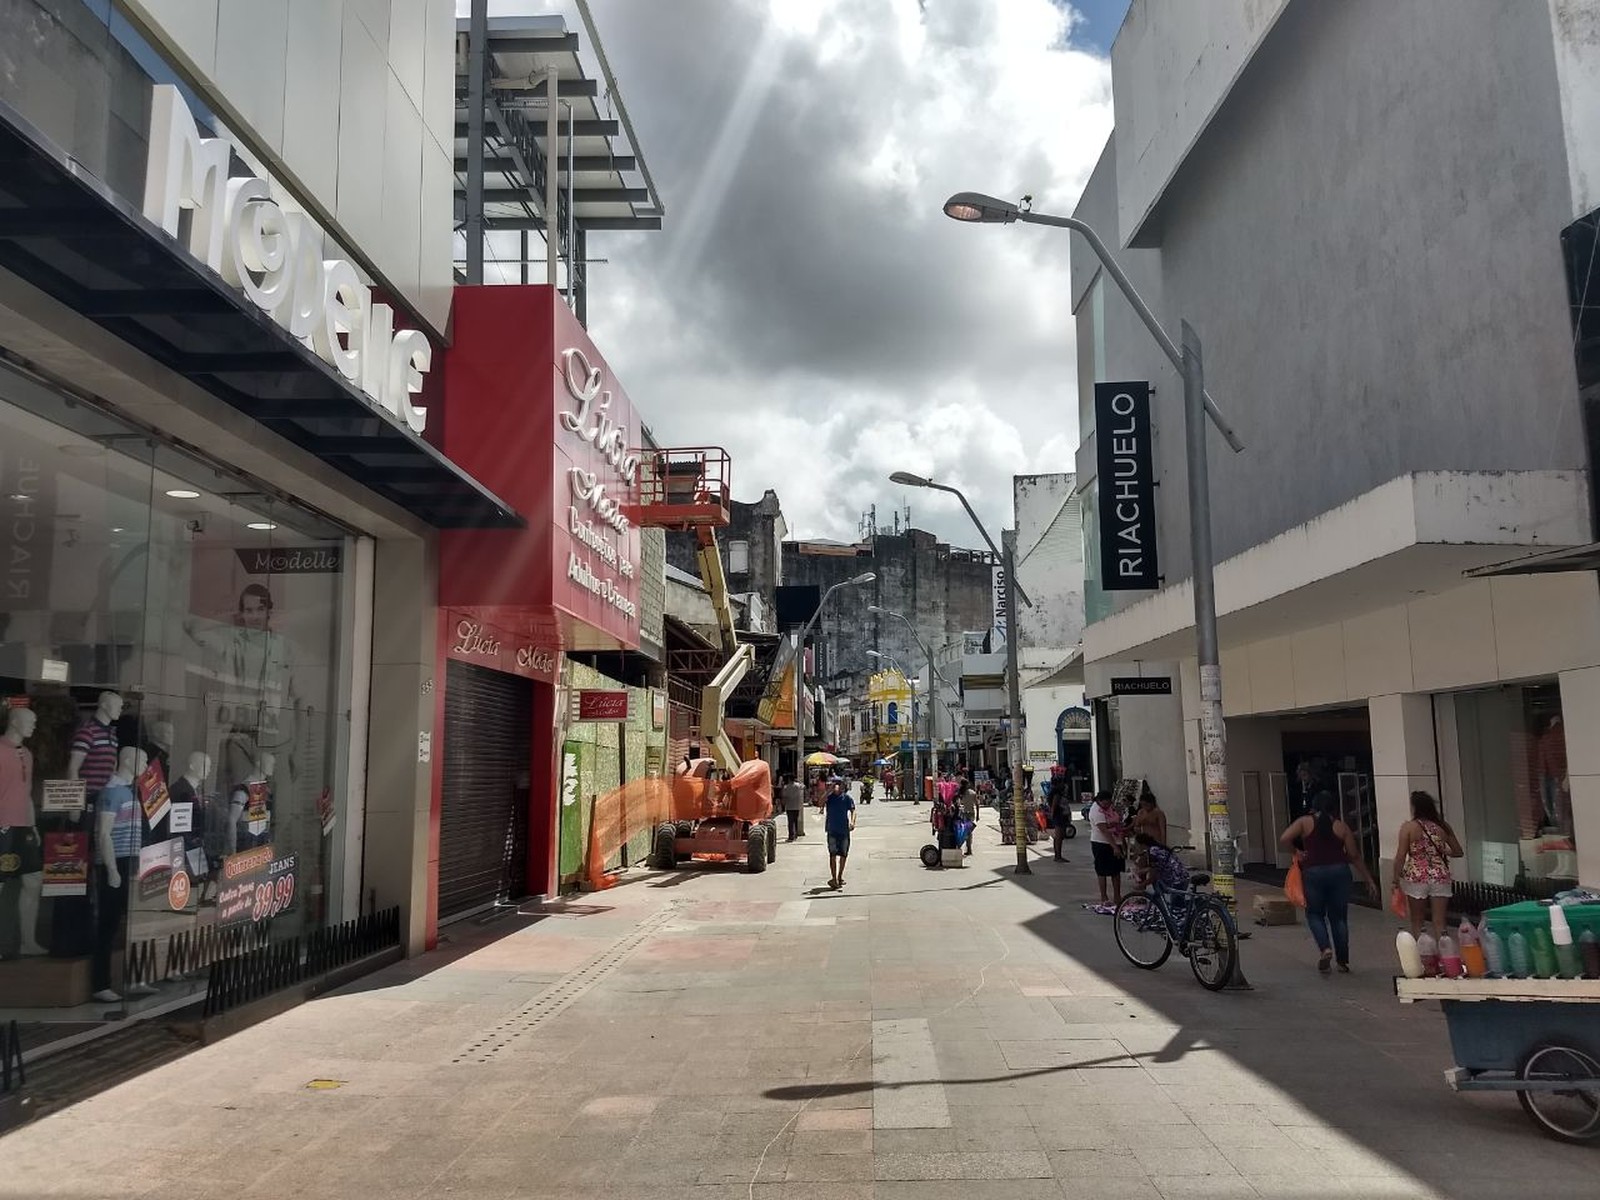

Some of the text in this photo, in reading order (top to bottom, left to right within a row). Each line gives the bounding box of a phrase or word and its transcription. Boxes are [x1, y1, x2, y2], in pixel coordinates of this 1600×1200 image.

[1112, 393, 1142, 577] RIACHUELO
[255, 550, 339, 571] Modelle
[994, 571, 1006, 617] Narciso
[453, 620, 500, 656] Lúcia
[1114, 681, 1169, 691] RIACHUELO
[269, 856, 295, 875] JEANS
